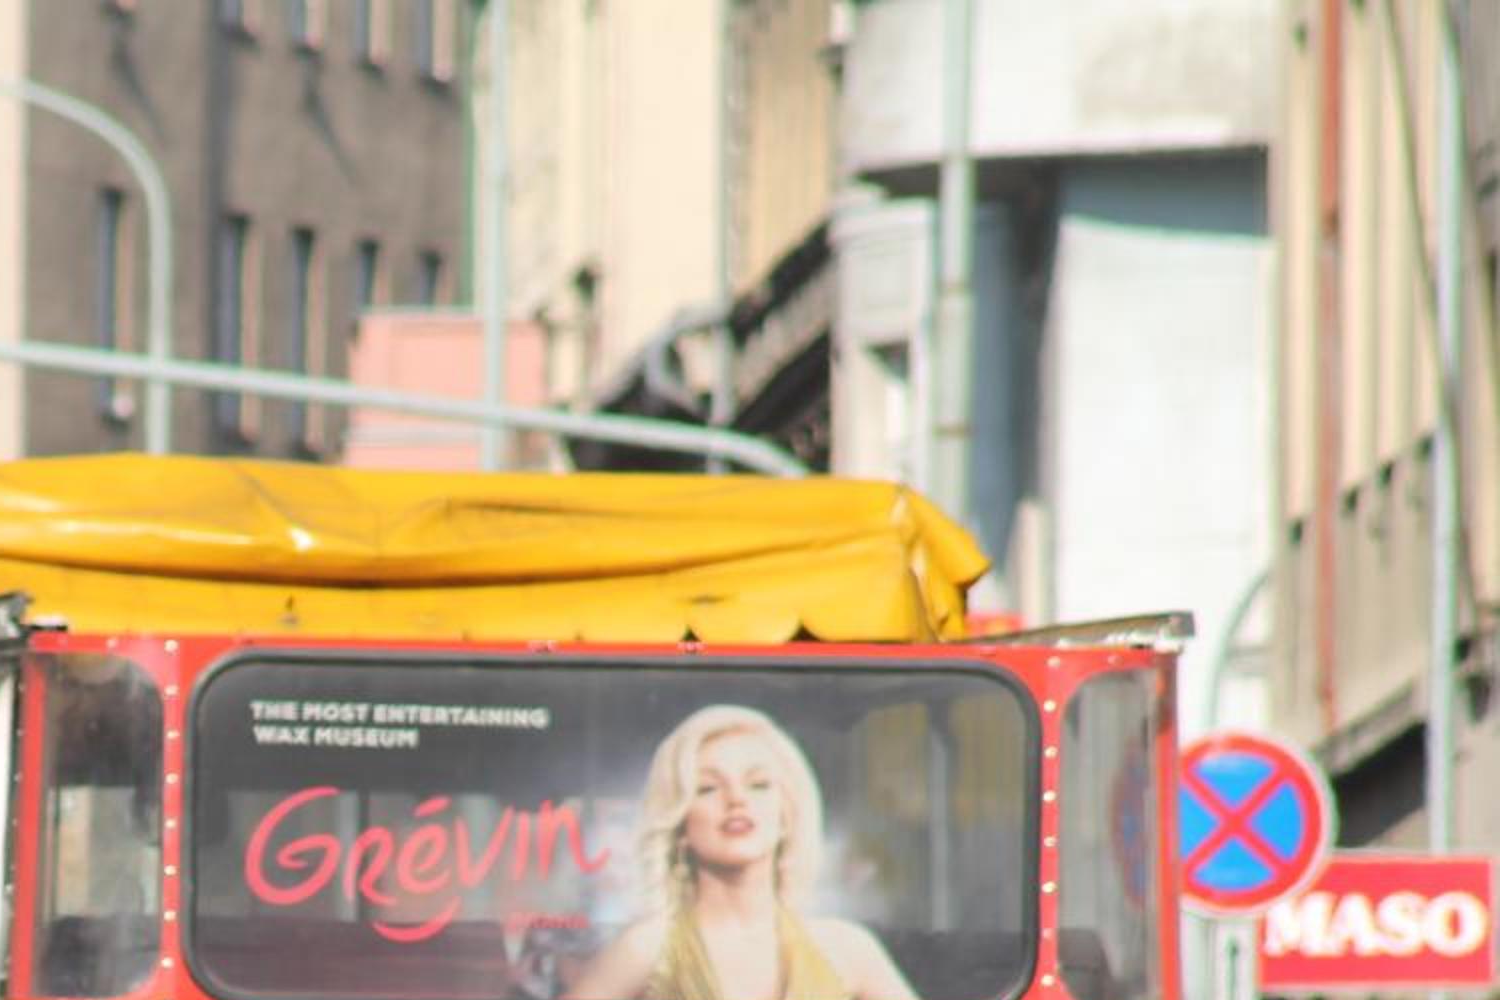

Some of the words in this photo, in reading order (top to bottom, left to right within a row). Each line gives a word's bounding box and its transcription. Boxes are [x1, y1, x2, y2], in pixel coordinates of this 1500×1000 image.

[250, 702, 298, 721] THE
[302, 703, 372, 723] MOST
[373, 704, 549, 729] ENTERTAINING
[253, 726, 311, 745] WAX
[314, 727, 420, 749] MUSEUM
[1264, 891, 1486, 957] MASO
